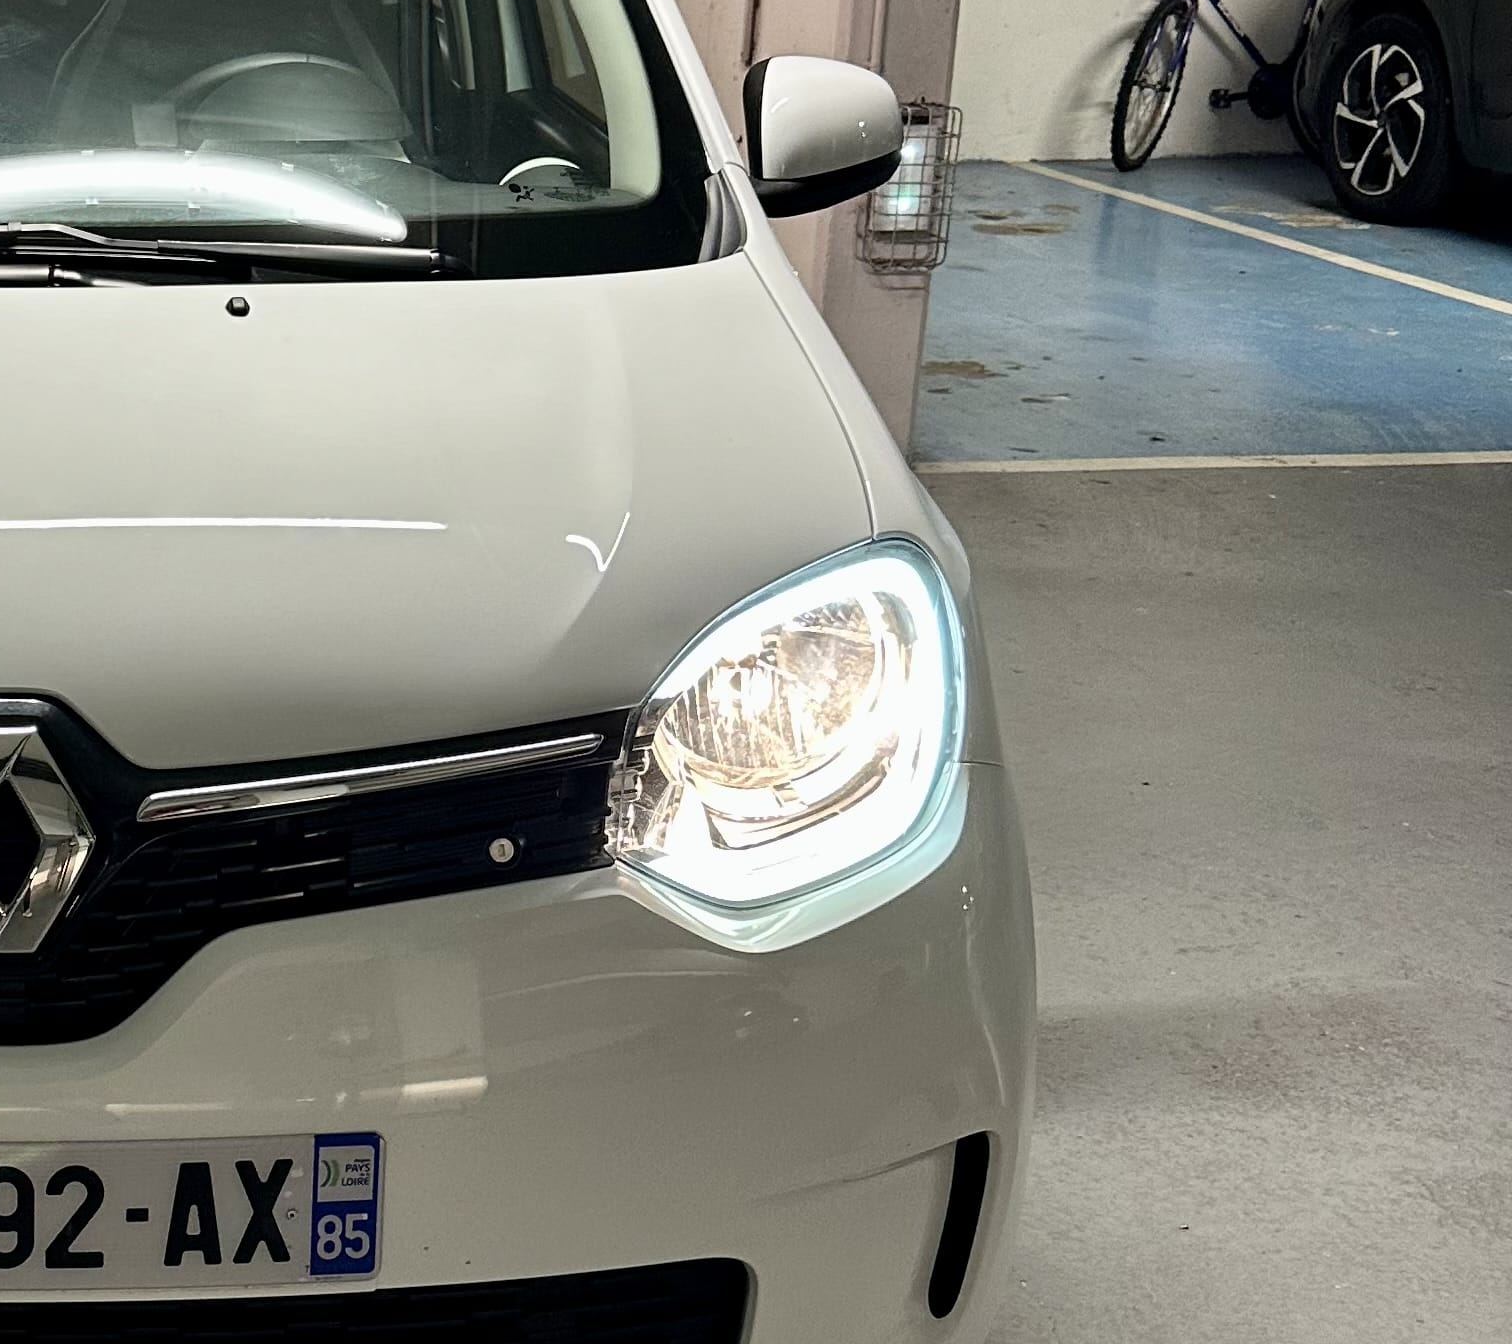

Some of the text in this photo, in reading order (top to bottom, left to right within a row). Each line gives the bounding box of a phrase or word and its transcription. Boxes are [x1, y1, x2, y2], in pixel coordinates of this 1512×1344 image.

[345, 1163, 371, 1173] PAYS
[341, 1177, 370, 1187] LOIRE
[316, 1213, 370, 1261] 85
